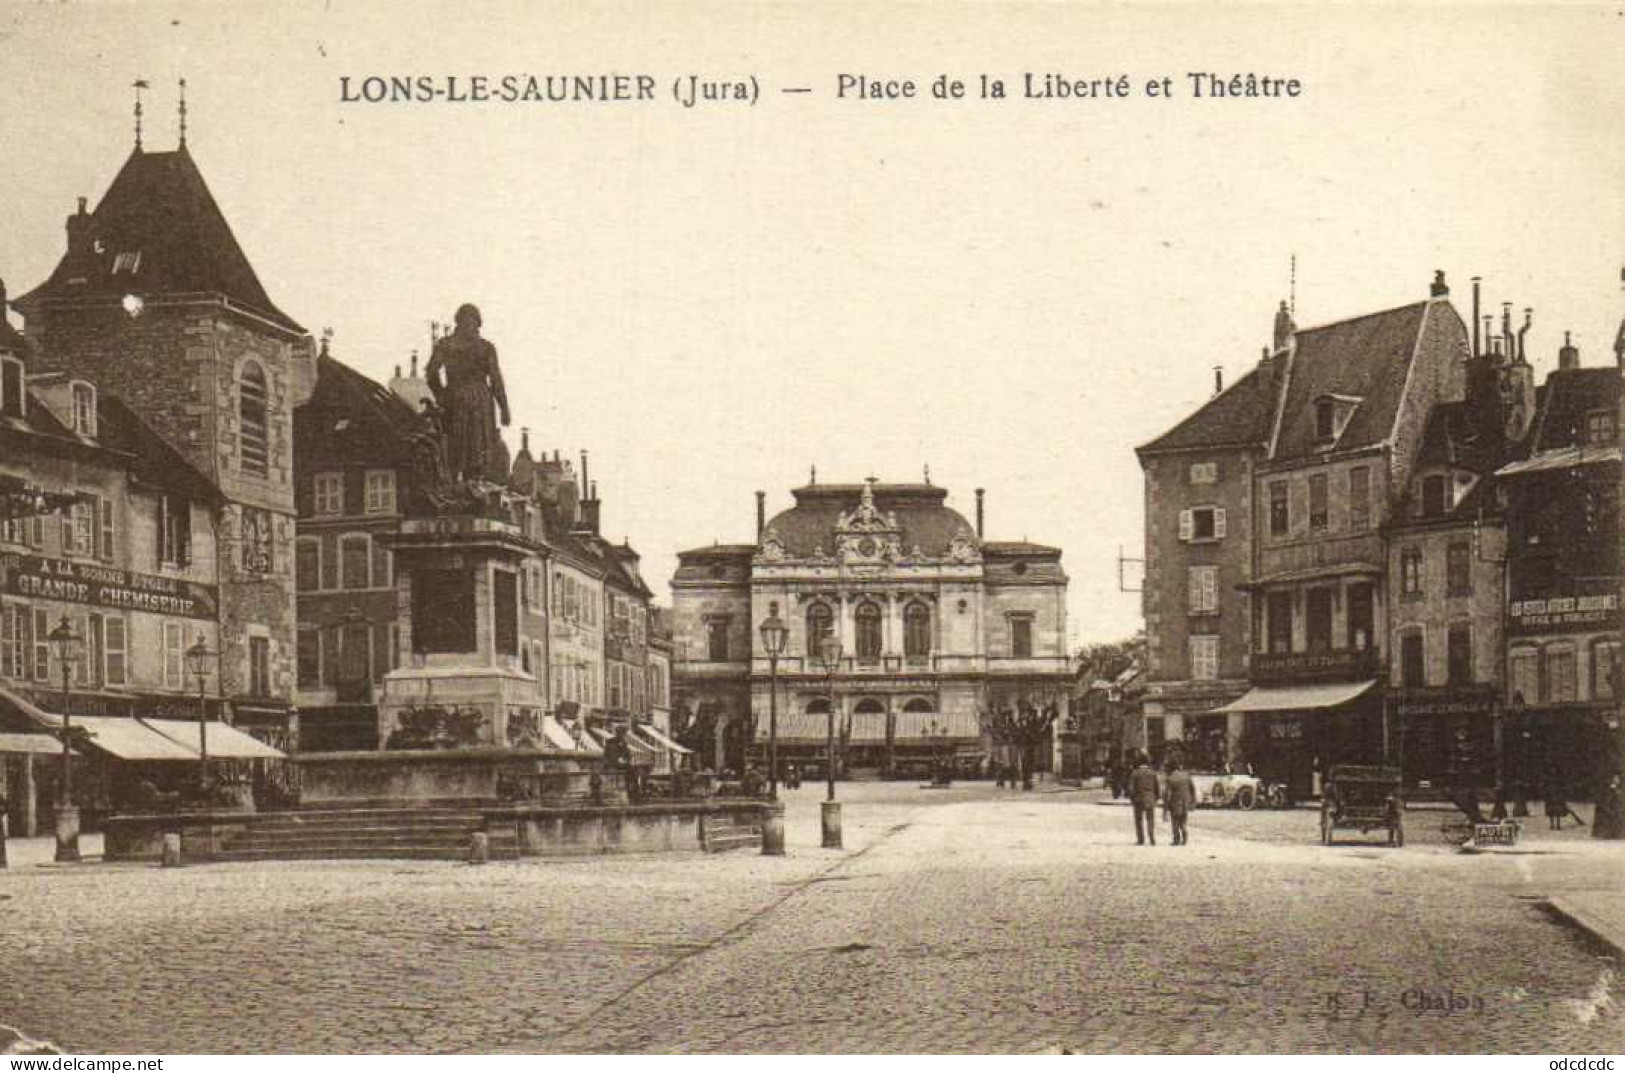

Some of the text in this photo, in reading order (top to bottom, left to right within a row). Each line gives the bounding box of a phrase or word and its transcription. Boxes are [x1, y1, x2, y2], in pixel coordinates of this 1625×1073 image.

[41, 559, 50, 574] A
[18, 574, 195, 615] GRANDE CHEMISERIE
